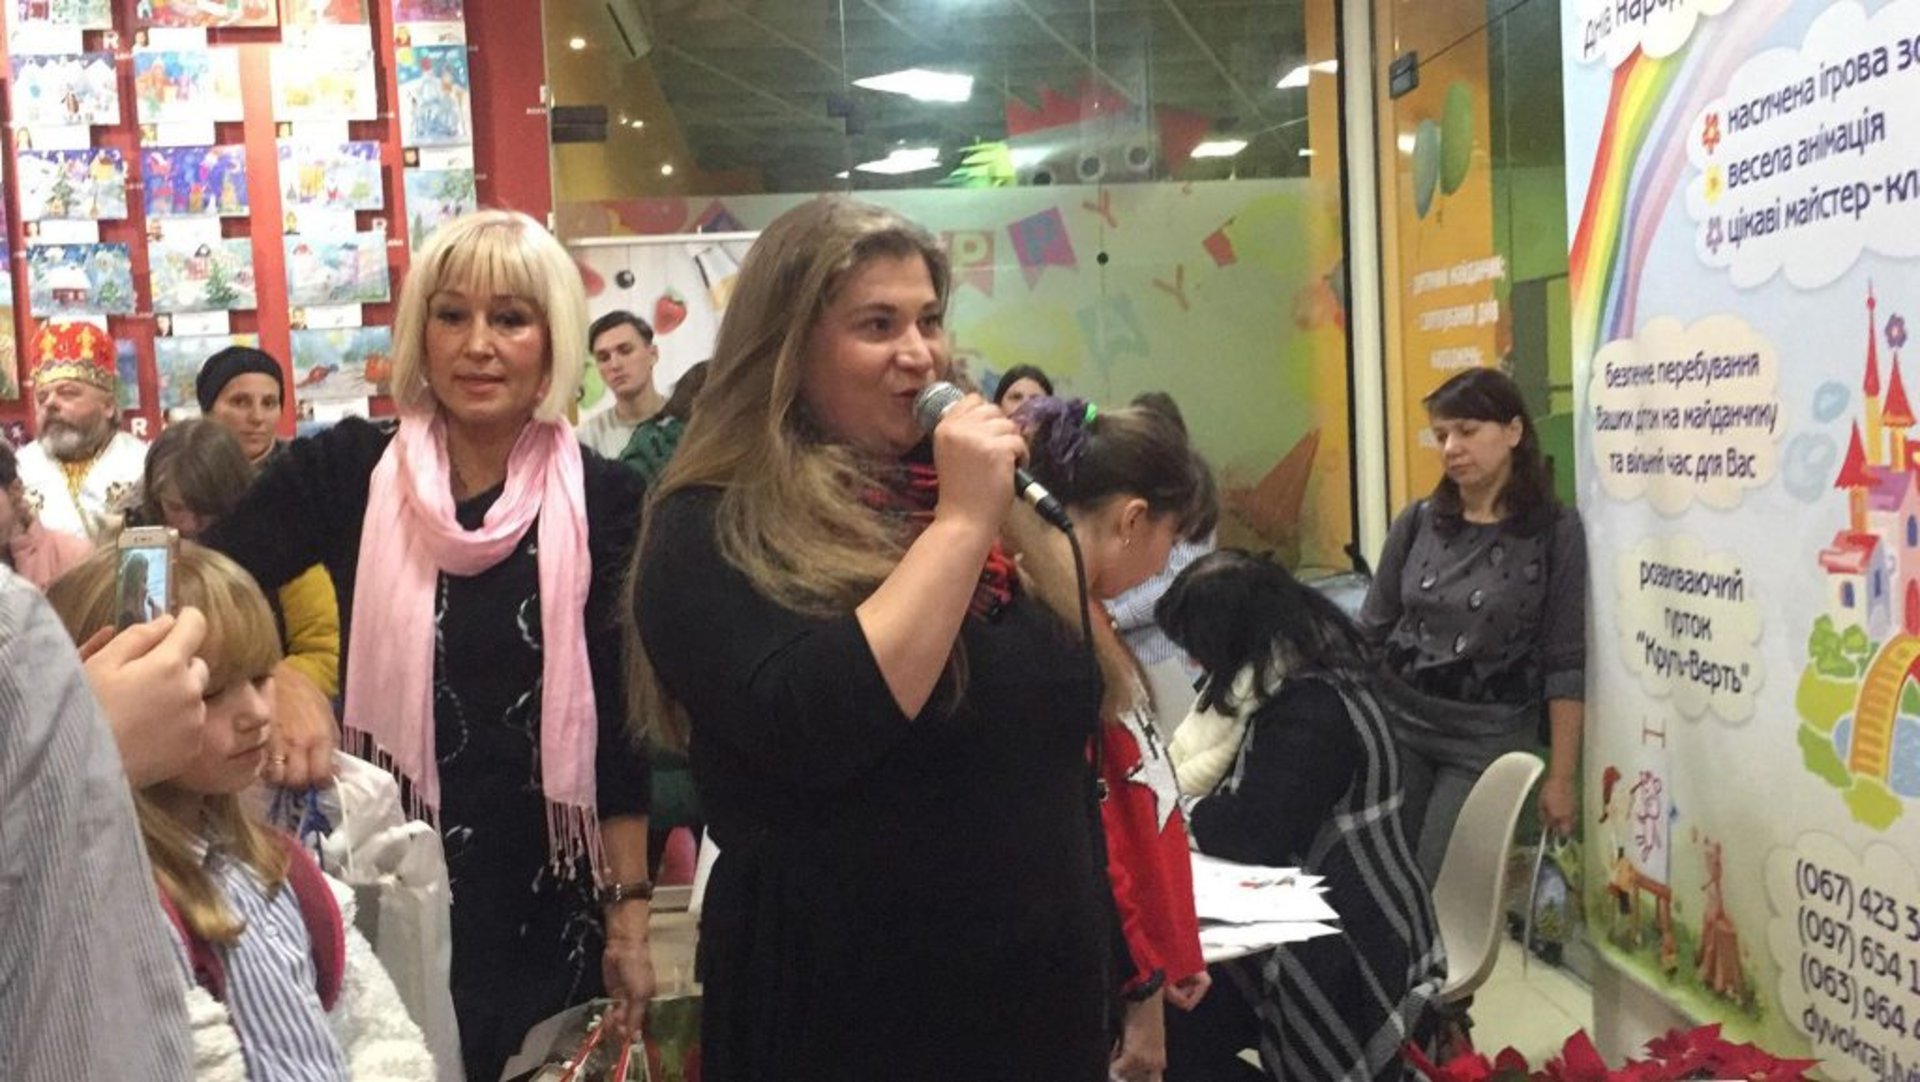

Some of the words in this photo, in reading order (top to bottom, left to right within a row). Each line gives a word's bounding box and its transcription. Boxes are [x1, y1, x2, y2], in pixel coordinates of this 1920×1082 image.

[1728, 76, 1815, 134] насичена
[1820, 46, 1889, 101] ігрова
[1728, 149, 1792, 189] весела
[1797, 106, 1885, 166] анімація
[1728, 198, 1782, 249] цікаві
[1657, 350, 1760, 390] перебування
[1662, 407, 1679, 430] на
[1683, 399, 1778, 435] майданчику
[1610, 453, 1623, 474] та
[1667, 453, 1693, 477] час
[1695, 453, 1723, 483] для
[1726, 447, 1756, 478] Вас
[1640, 560, 1743, 602] розвиваючий
[1796, 858, 1854, 921] (067)
[1859, 886, 1898, 932] 423
[1798, 905, 1855, 969] (097)
[1860, 935, 1901, 985] 654
[1801, 952, 1858, 1019] (063)
[1863, 986, 1906, 1038] 964
